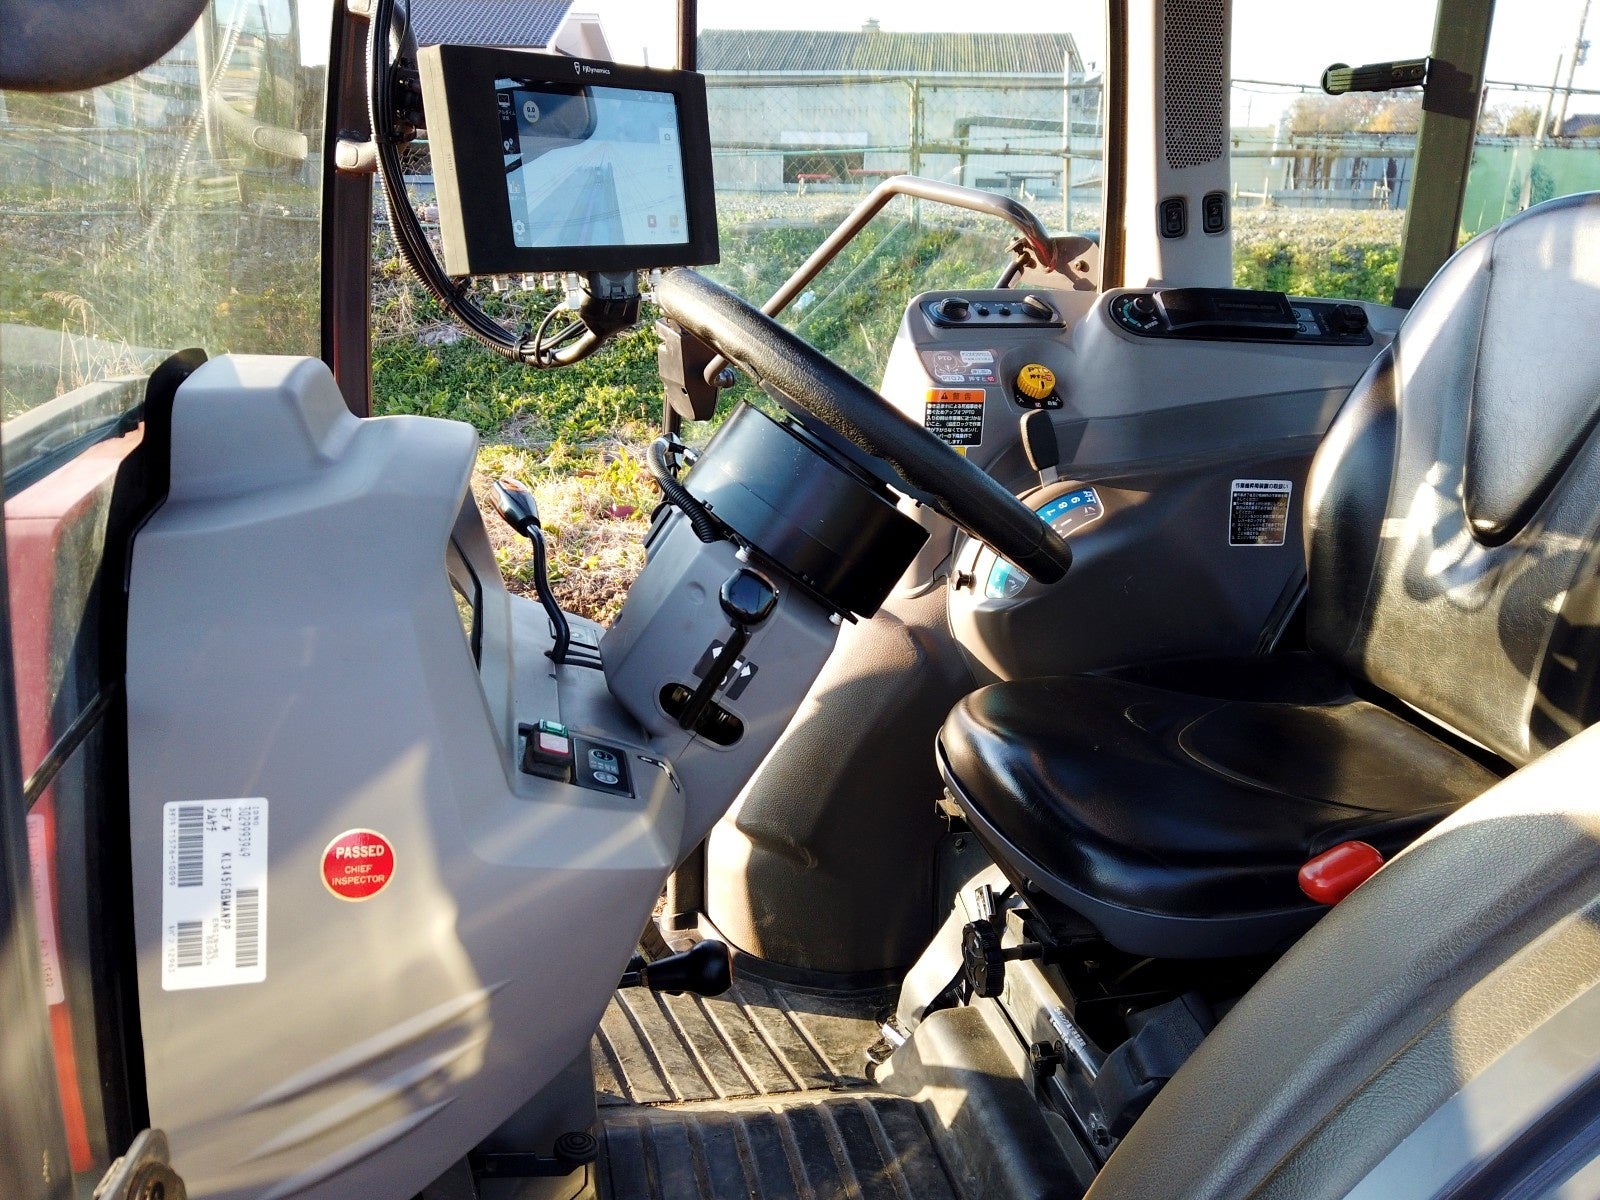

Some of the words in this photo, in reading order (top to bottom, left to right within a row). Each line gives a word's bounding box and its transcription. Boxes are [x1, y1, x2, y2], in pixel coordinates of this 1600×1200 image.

[1058, 501, 1068, 509] 8
[335, 844, 385, 860] PASSED
[344, 864, 373, 875] CHIEF
[331, 874, 386, 886] INSPECTOR
